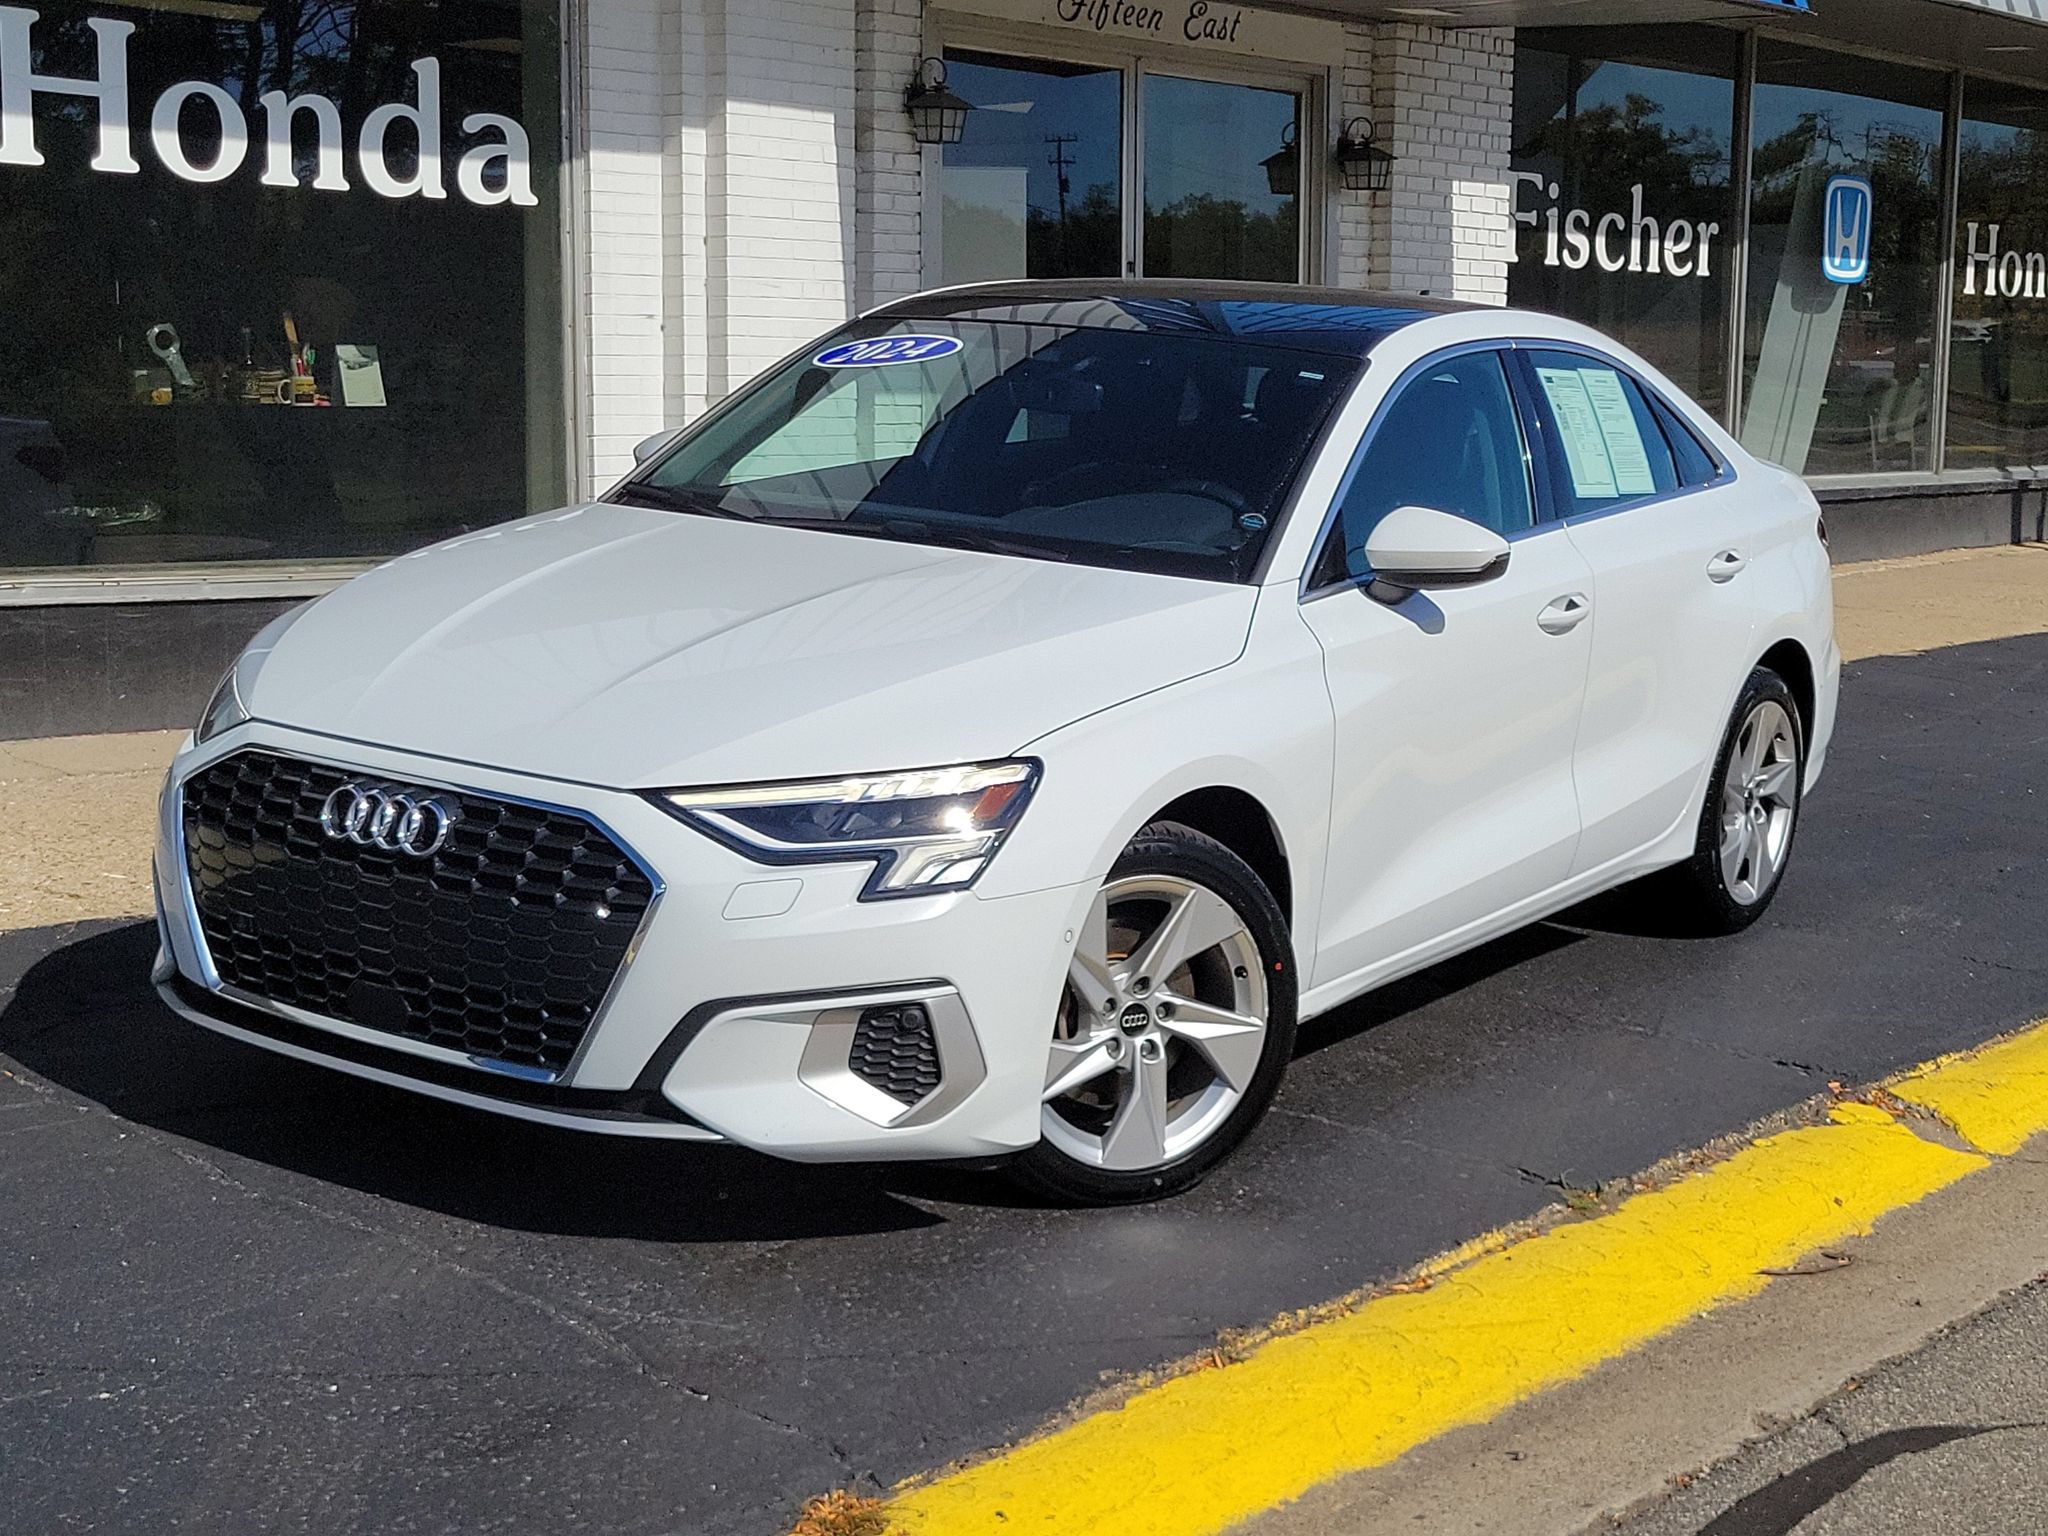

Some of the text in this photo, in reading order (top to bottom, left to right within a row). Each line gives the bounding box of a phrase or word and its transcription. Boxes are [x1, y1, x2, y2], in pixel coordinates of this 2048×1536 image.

[1183, 1, 1241, 43] East
[0, 6, 540, 206] Honda
[1508, 169, 1720, 277] Fischer
[825, 340, 947, 364] 2024
